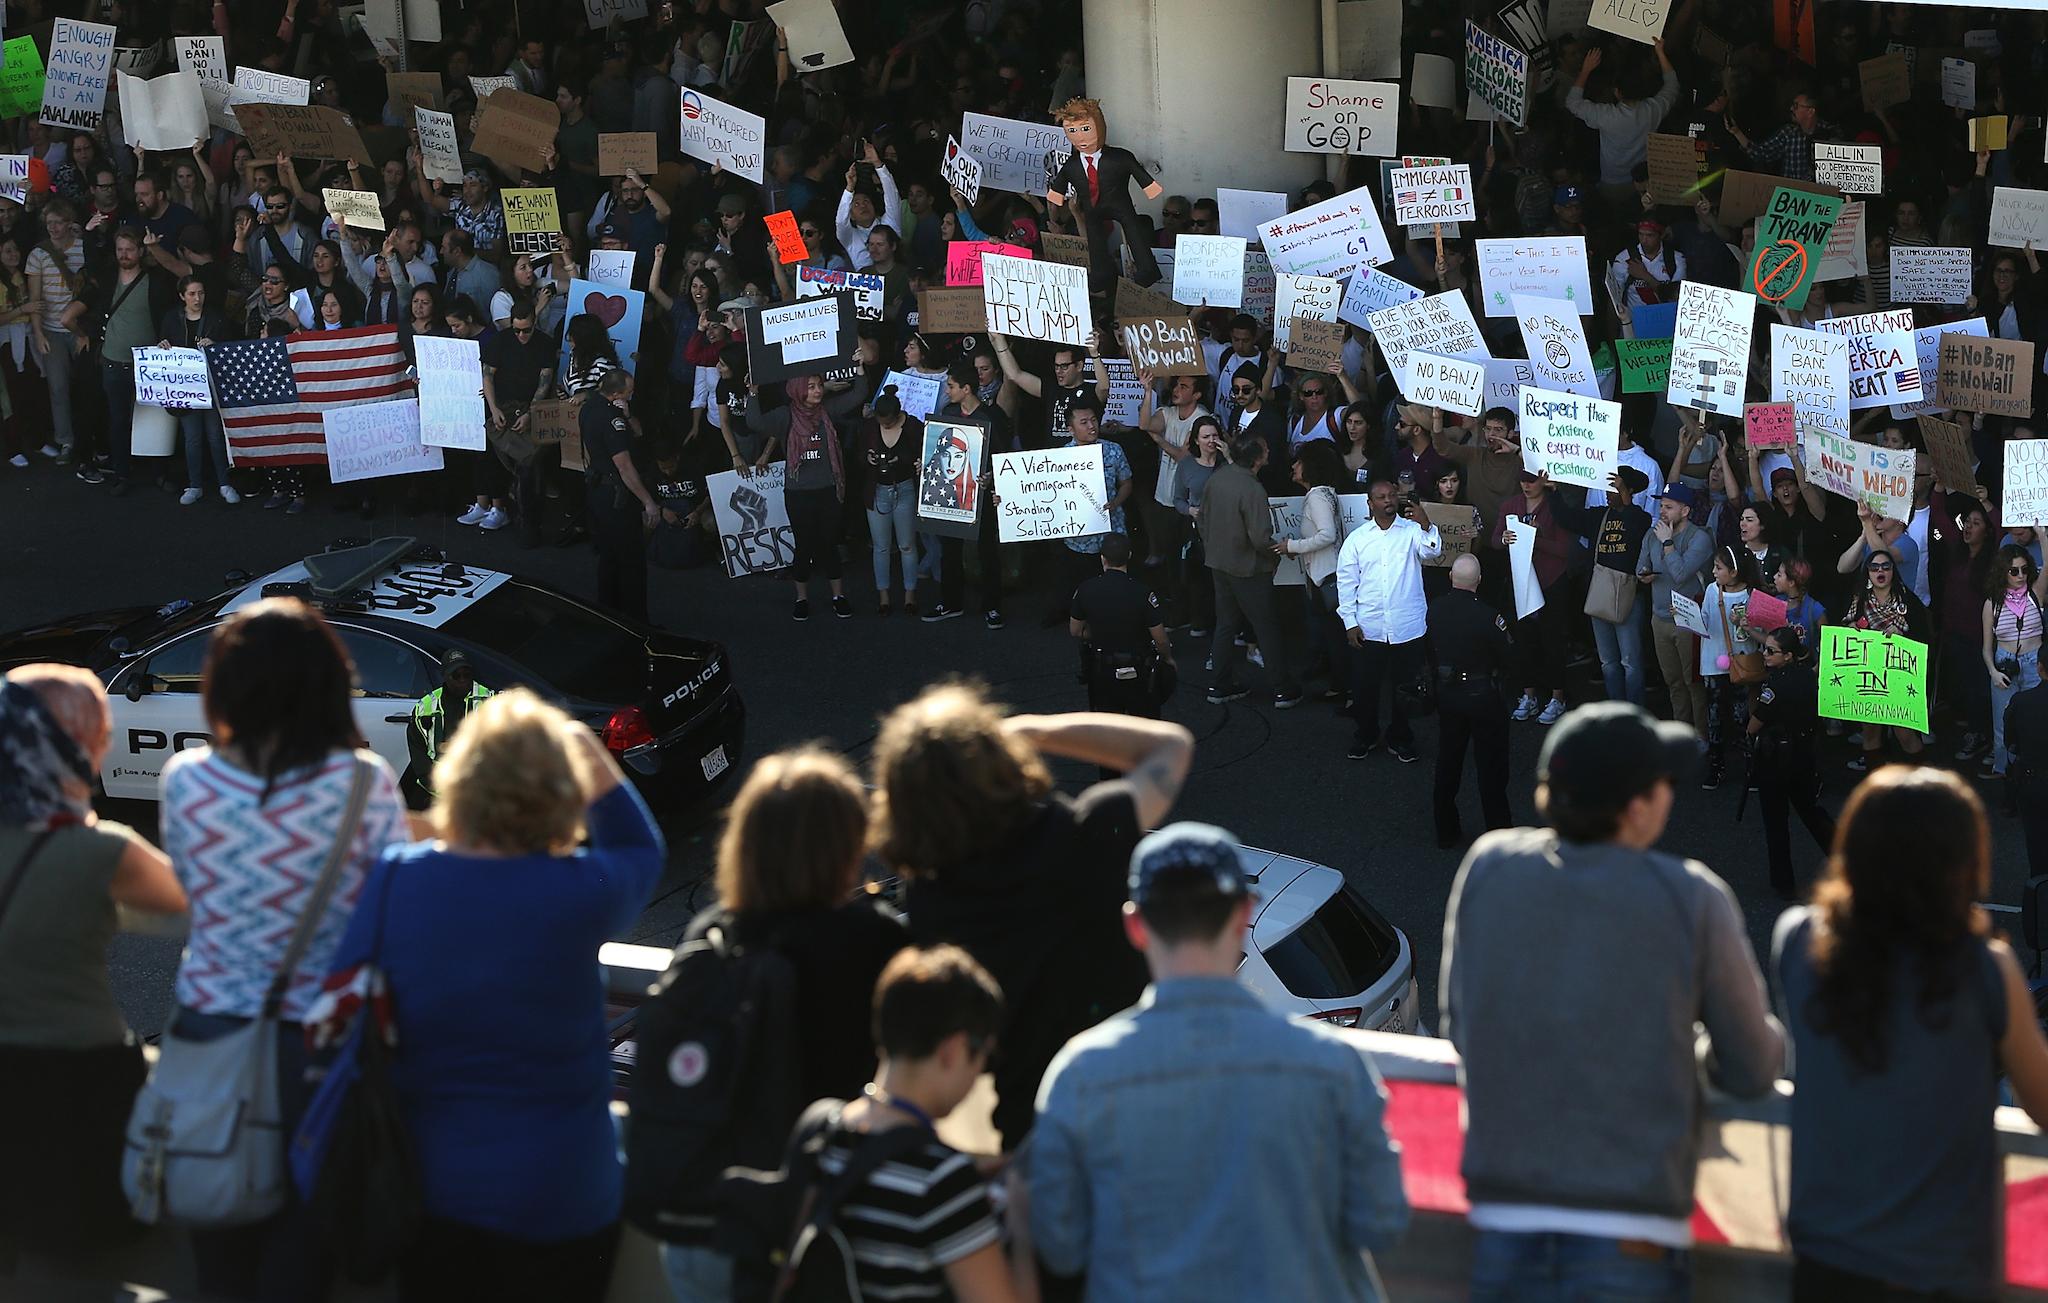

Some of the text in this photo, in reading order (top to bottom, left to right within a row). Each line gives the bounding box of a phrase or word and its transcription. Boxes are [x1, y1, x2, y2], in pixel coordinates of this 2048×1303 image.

[57, 23, 112, 48] ENOUGH
[191, 39, 206, 50] NO
[186, 49, 217, 64] BAN!
[1465, 22, 1525, 74] AMERICA
[52, 48, 107, 71] ANGRY
[193, 60, 208, 70] NO
[47, 66, 107, 90] SNOWFLAKES
[235, 68, 310, 99] PROTECT
[1467, 52, 1525, 103] WELCOMES
[52, 85, 66, 100] IS
[74, 91, 95, 104] AN
[1307, 83, 1384, 110] Shame
[1466, 68, 1523, 124] REFUGEES
[41, 104, 103, 130] AVALANCHE
[430, 116, 453, 128] HUMAN
[1334, 111, 1358, 125] on
[968, 121, 1010, 143] WE THE
[1306, 121, 1373, 152] GOP
[681, 125, 707, 143] WHY
[731, 153, 761, 170] YOU?!
[1826, 147, 1865, 161] ALL IN
[10, 159, 26, 176] IN
[957, 156, 979, 184] OUR
[1815, 162, 1875, 174] NO DEPORTATIONS
[1818, 171, 1876, 184] NO DETENTIONS
[942, 157, 979, 202] MUSLIMS
[1392, 169, 1469, 190] IMMIGRANT
[1838, 181, 1876, 193] BORDERS
[503, 193, 554, 211] WE WANT
[1396, 202, 1472, 223] TERRORIST
[1774, 191, 1832, 217] BAN THE
[1998, 199, 2022, 209] NEVER
[1360, 217, 1371, 231] 2
[1767, 213, 1833, 246] TYRANT
[2001, 213, 2039, 234] NOW
[511, 235, 560, 254] HERE
[781, 245, 802, 257] ME
[1181, 240, 1240, 259] BORDERS
[1907, 249, 1954, 257] IMMIGRATION
[591, 253, 629, 281] Resist
[950, 259, 981, 283] WHITE
[1050, 264, 1086, 289] SECURITY
[1208, 270, 1238, 281] THAT?
[1372, 272, 1406, 294] KEEP
[988, 276, 1071, 315] DETAIN
[1683, 284, 1735, 309] NEVER
[765, 303, 838, 327] MUSLIM LIVES
[1370, 296, 1449, 328] GIVE ME YOUR
[1680, 307, 1750, 336] REFUGEES
[1403, 315, 1430, 333] YOUR
[1524, 315, 1580, 344] NO PEACE
[1820, 311, 1914, 337] IMMIGRANTS
[783, 329, 828, 347] MATTER
[1303, 332, 1328, 345] BACK
[1381, 320, 1475, 355] YOUR HUDDLED MASSES
[1442, 333, 1479, 355] BREATHE
[1540, 333, 1563, 343] WITH
[1679, 322, 1749, 358] WELCOME
[1781, 332, 1848, 361] MUSLIM
[1918, 331, 1936, 346] to
[137, 347, 204, 371] Immigrants
[1303, 356, 1328, 367] TODAY
[1674, 345, 1697, 361] FUCK
[1674, 356, 1698, 371] TRUMP
[1719, 357, 1741, 370] FUCK
[1791, 353, 1826, 371] BAN:
[1944, 344, 2015, 374] #NoBan
[139, 364, 207, 389] Refugees
[1416, 361, 1435, 379] NO
[1440, 364, 1479, 391] BAN!
[1672, 369, 1695, 381] FUCK
[1718, 366, 1745, 379] BANNON
[1781, 370, 1834, 393] INSANE,
[139, 385, 207, 403] Welcome
[1943, 372, 2013, 398] #NoWall
[159, 400, 192, 410] HERE
[1415, 386, 1483, 413] NO WALL!
[1525, 392, 1611, 423] Respect their
[1786, 389, 1837, 412] RACIST,
[1942, 390, 1969, 409] We're
[1990, 396, 2030, 411] Immigrants
[537, 409, 577, 421] THIS IS
[1548, 422, 1596, 441] existence
[1525, 436, 1606, 462] OR expect our
[1814, 430, 1890, 469] THIS IS
[2008, 441, 2030, 466] NO
[1000, 457, 1095, 477] A Vietnamese
[1546, 461, 1598, 481] resistance
[1821, 453, 1908, 498] NOT WHO
[2008, 465, 2022, 486] IS
[1020, 474, 1077, 504] immigrant
[1825, 472, 1854, 499] WE
[2005, 487, 2035, 504] WHEN
[1005, 500, 1055, 524] Standing
[1064, 499, 1077, 511] in
[2011, 502, 2034, 513] ARE
[1016, 518, 1085, 541] Solidarity
[1832, 635, 1918, 678] LET THEM
[662, 660, 721, 709] POLICE
[1855, 670, 1888, 691] IN
[1831, 695, 1920, 724] #NOBANNOWALL
[124, 768, 139, 776] Los
